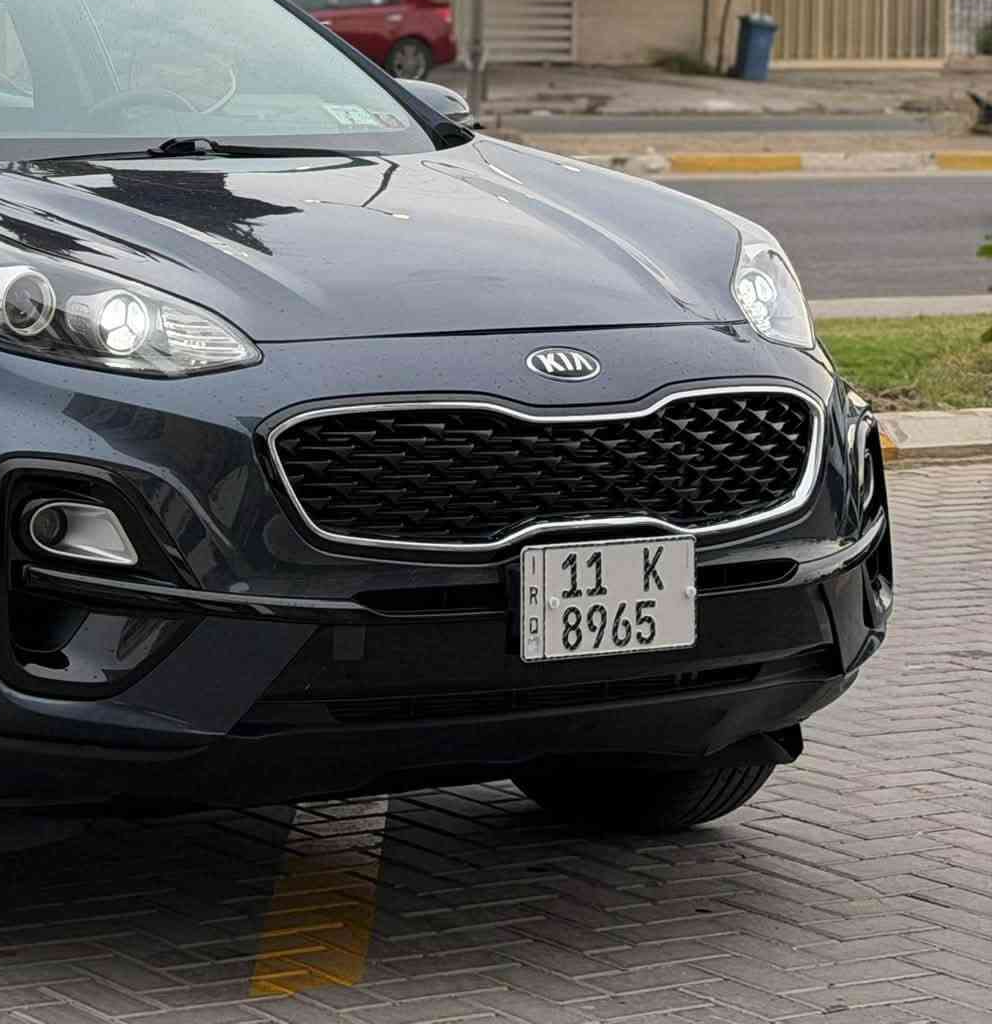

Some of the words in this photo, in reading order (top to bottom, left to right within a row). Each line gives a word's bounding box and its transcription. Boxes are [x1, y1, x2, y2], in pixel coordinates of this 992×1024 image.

[536, 352, 594, 373] KIA
[561, 552, 608, 599] 11
[643, 545, 665, 593] K
[561, 600, 657, 651] 8965
